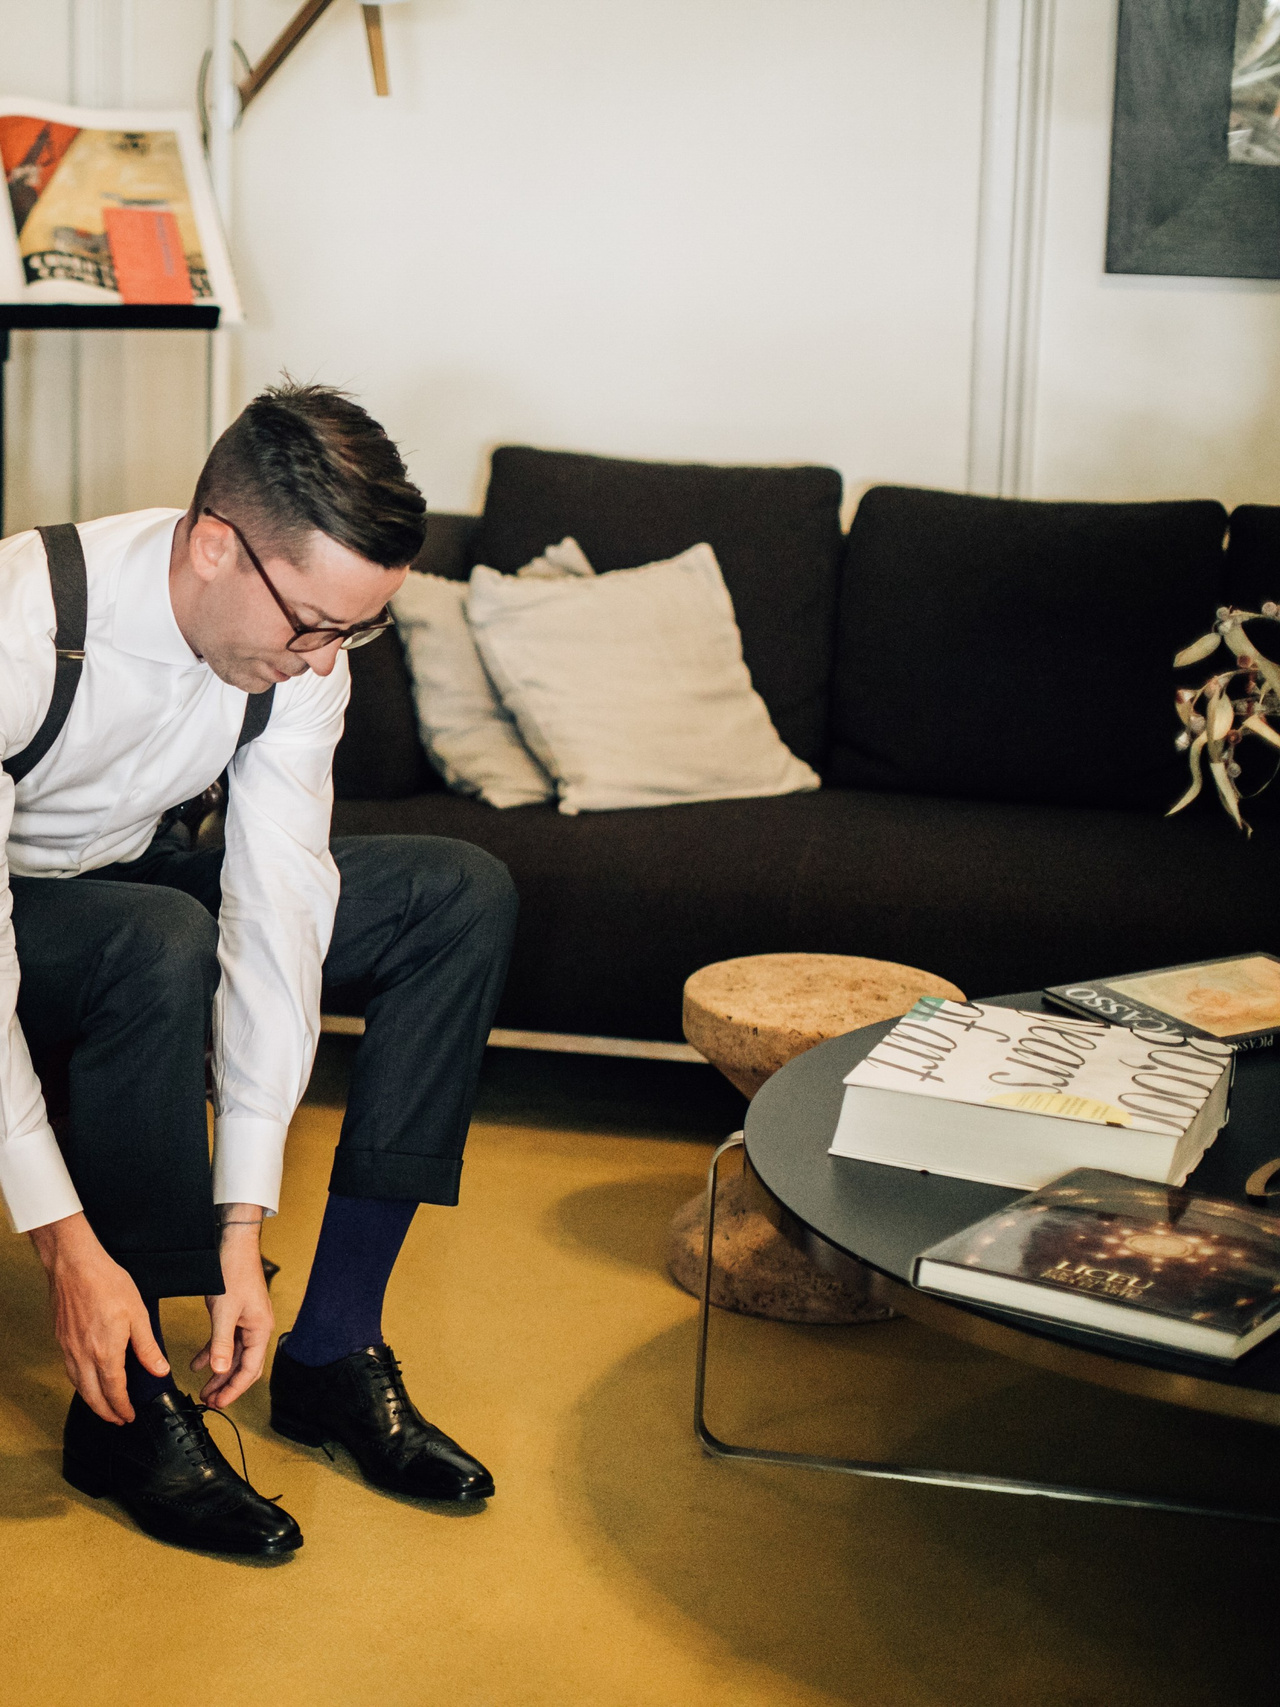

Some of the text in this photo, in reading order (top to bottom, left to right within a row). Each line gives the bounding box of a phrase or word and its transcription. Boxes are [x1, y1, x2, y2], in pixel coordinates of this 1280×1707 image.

[1064, 986, 1181, 1037] ICASSO
[864, 1021, 958, 1084] art
[988, 1009, 1112, 1095] years
[1237, 1035, 1274, 1052] PICASS
[1055, 1260, 1156, 1289] LICEU
